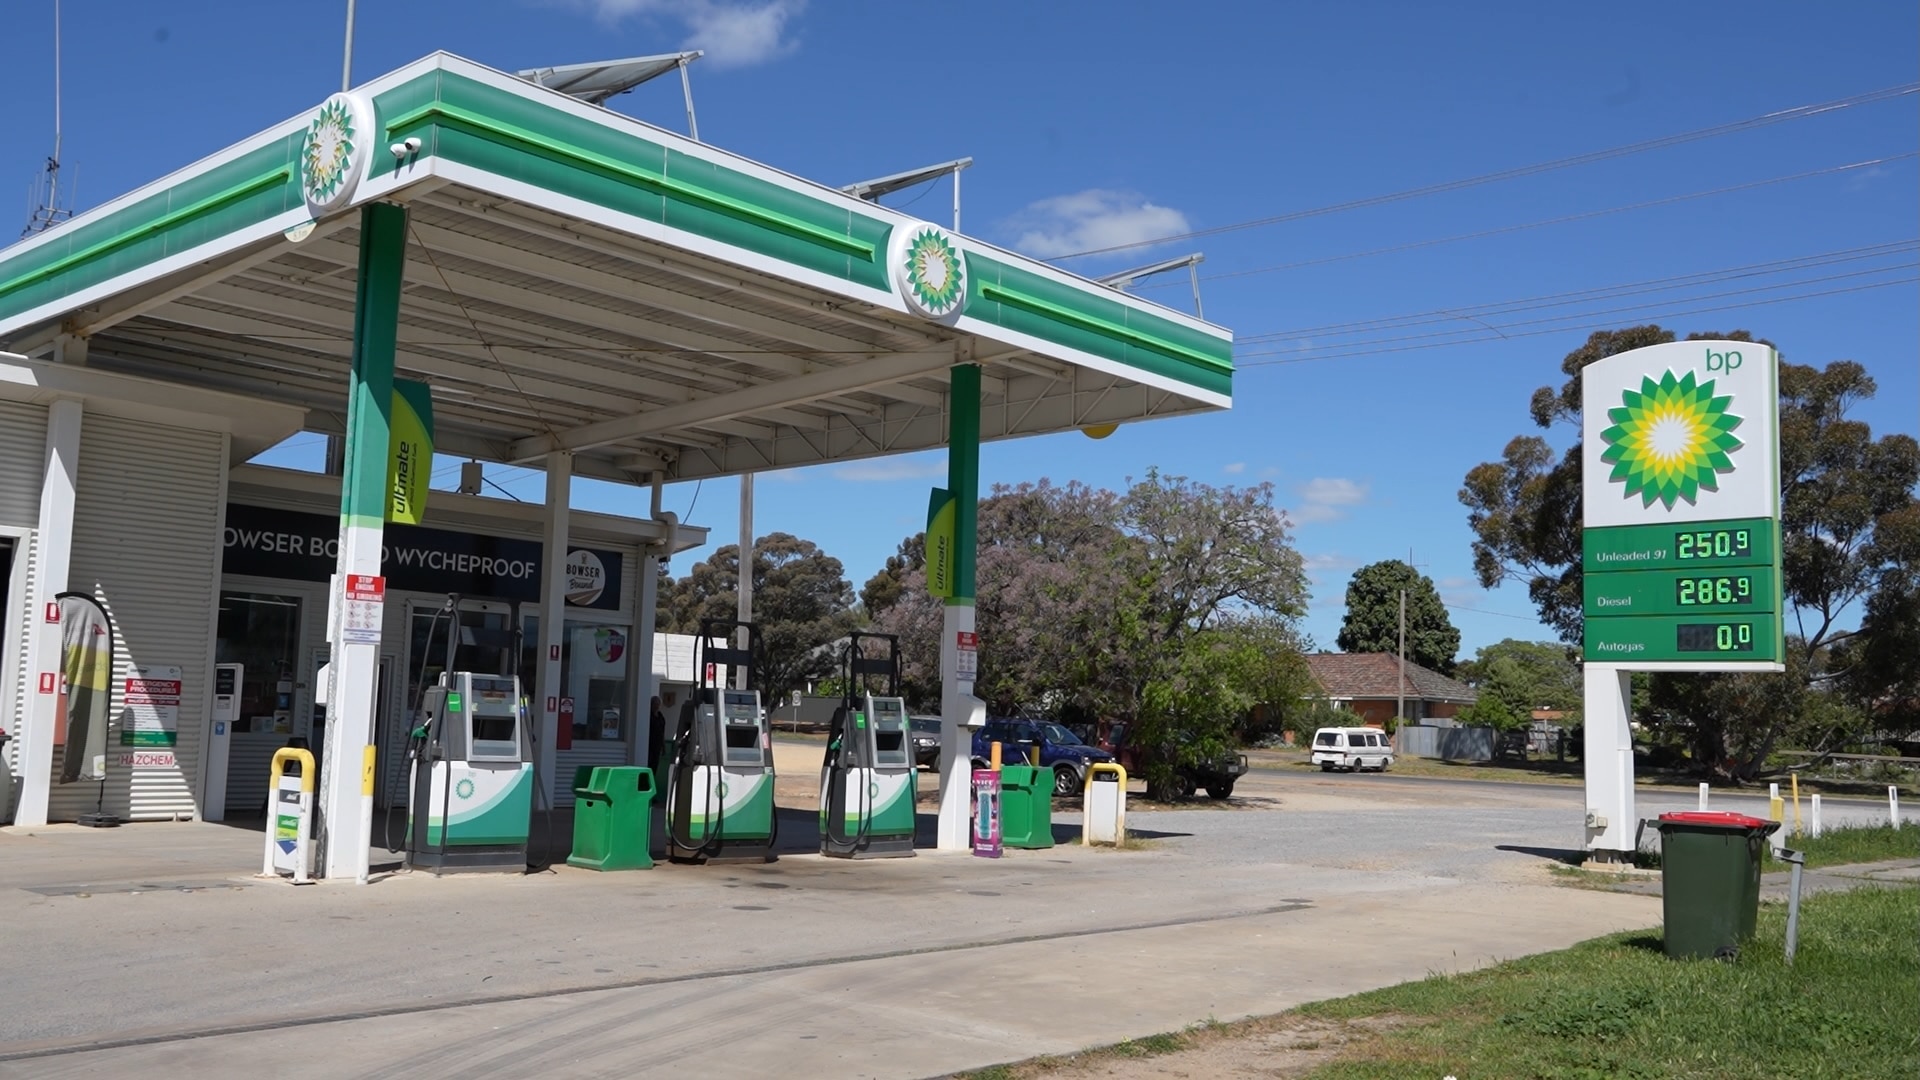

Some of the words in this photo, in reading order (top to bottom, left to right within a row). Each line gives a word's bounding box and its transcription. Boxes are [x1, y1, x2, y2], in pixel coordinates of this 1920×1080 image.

[1706, 348, 1743, 376] bp
[394, 441, 409, 514] ultimate
[223, 527, 304, 555] OWSER
[395, 546, 535, 579] WYCHEPROOF
[1596, 550, 1650, 562] Unleaded
[1653, 549, 1667, 560] 91
[1679, 530, 1748, 559] 250.9
[566, 564, 600, 578] BOWSER
[936, 535, 946, 590] ultimate
[1597, 596, 1632, 607] Diesel
[1680, 577, 1749, 604] 286.9
[1597, 641, 1645, 653] Autogas
[130, 686, 177, 694] PROCEDURES
[132, 679, 176, 688] EMERGENCY
[120, 754, 173, 766] HAZCHEM
